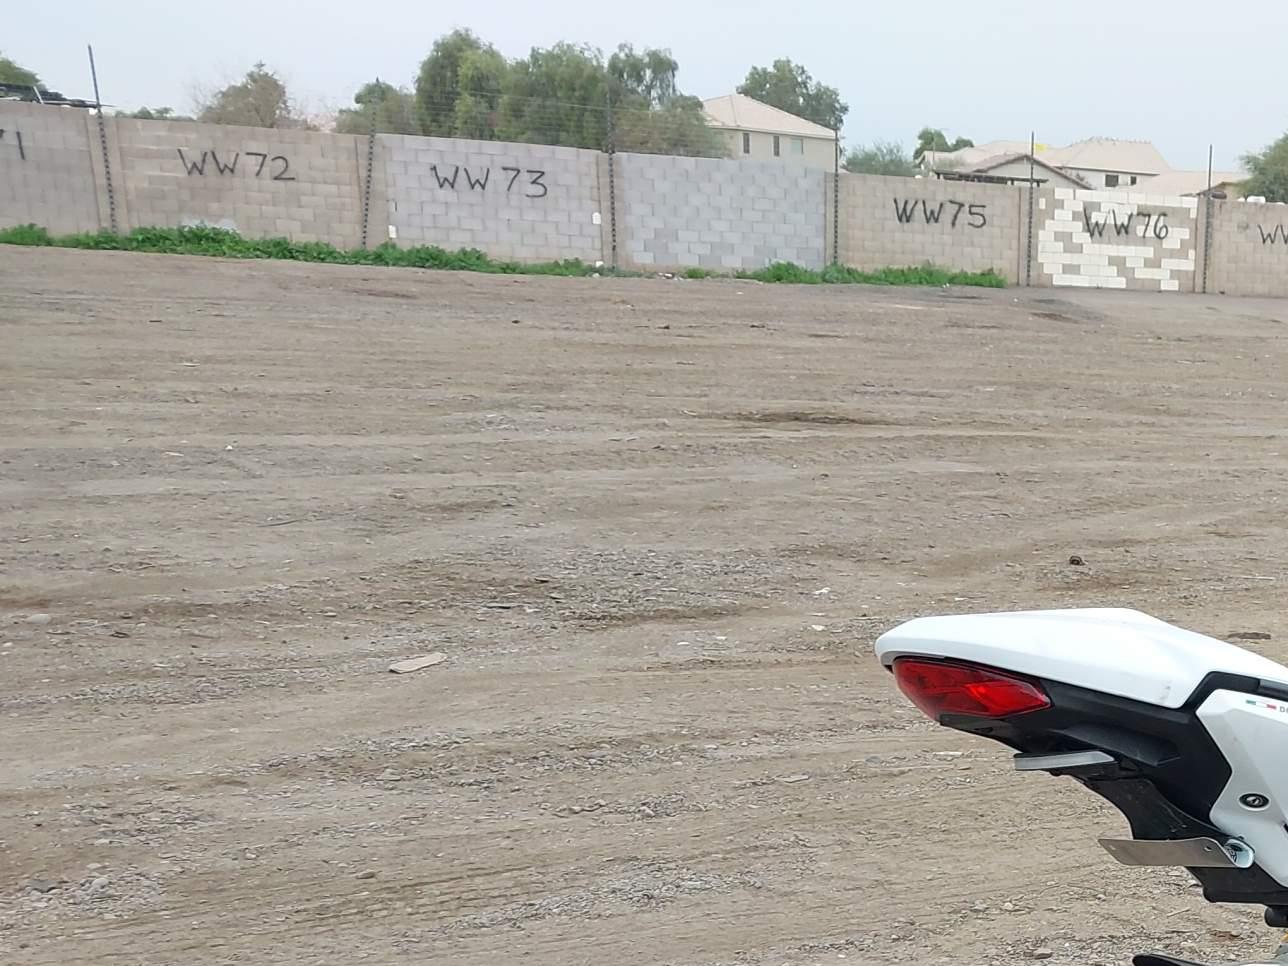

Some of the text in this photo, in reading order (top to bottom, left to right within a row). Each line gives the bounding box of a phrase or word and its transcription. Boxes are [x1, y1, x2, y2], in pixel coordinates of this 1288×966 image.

[179, 148, 295, 182] WW72
[893, 197, 988, 229] WW75
[1082, 206, 1170, 241] WW76
